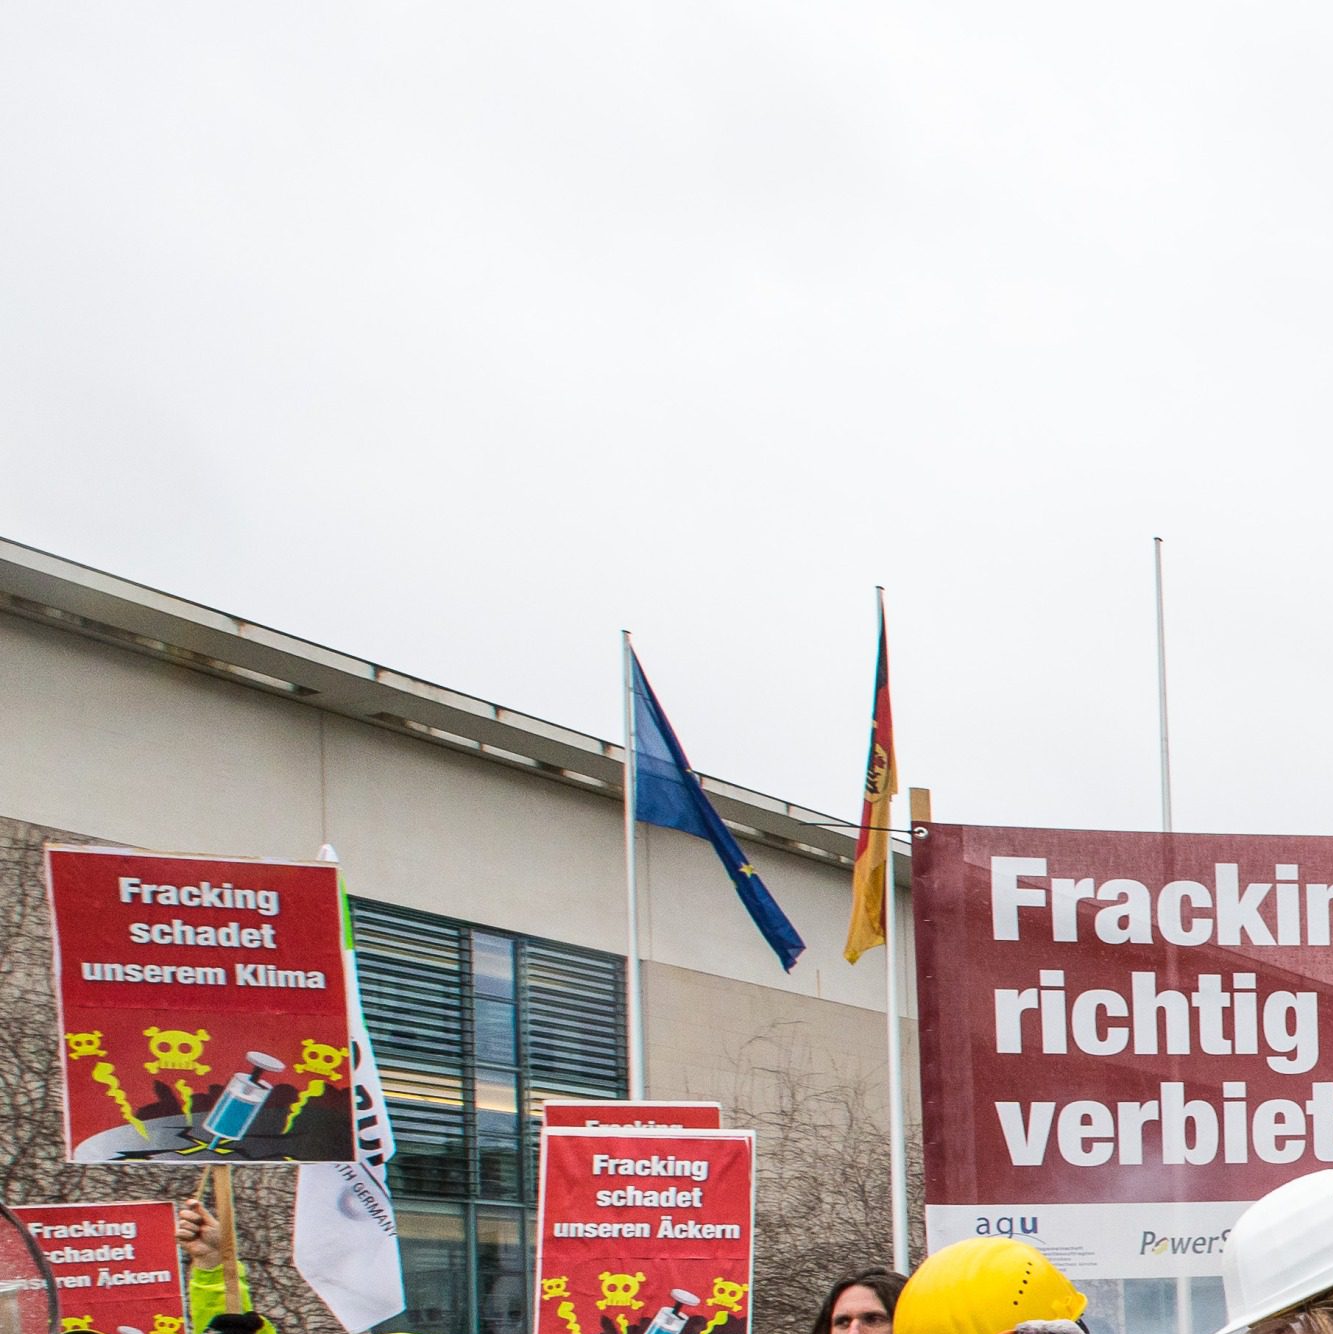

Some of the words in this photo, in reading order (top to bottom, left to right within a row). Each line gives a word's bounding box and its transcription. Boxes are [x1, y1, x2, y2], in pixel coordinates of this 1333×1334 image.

[118, 877, 280, 916] Fracking
[129, 919, 277, 949] schadet
[81, 961, 227, 986] unserem
[235, 963, 327, 989] Klima
[994, 969, 1320, 1075] richtig
[592, 1154, 708, 1181] Fracking
[596, 1186, 703, 1208] schadet
[553, 1221, 650, 1238] unseren
[657, 1215, 740, 1239] Äckern
[44, 1244, 135, 1263] chadet
[97, 1268, 172, 1287] Äckern
